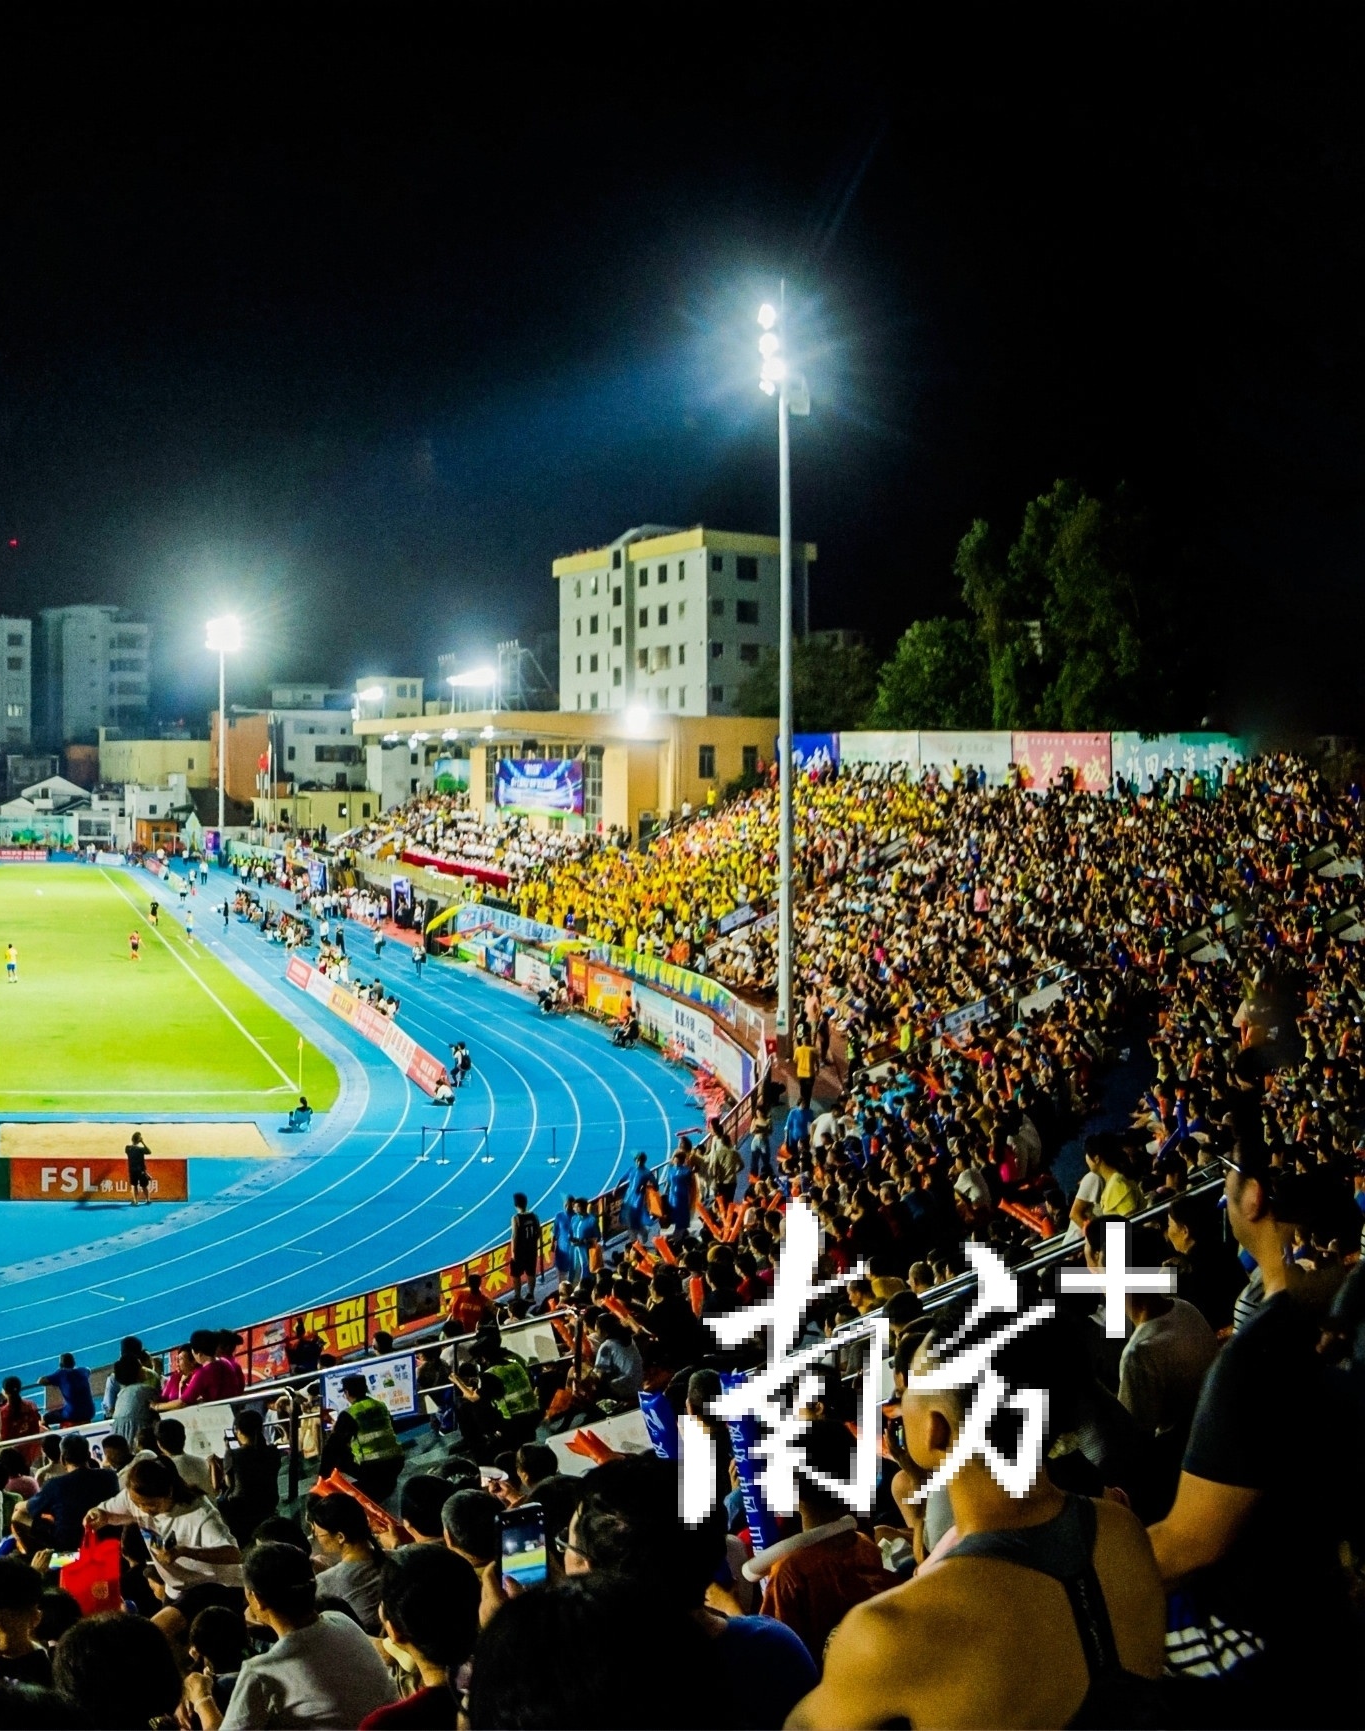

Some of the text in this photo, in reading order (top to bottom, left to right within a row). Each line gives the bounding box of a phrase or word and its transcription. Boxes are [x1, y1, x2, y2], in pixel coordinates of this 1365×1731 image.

[40, 1166, 158, 1194] FSL 佛山明
